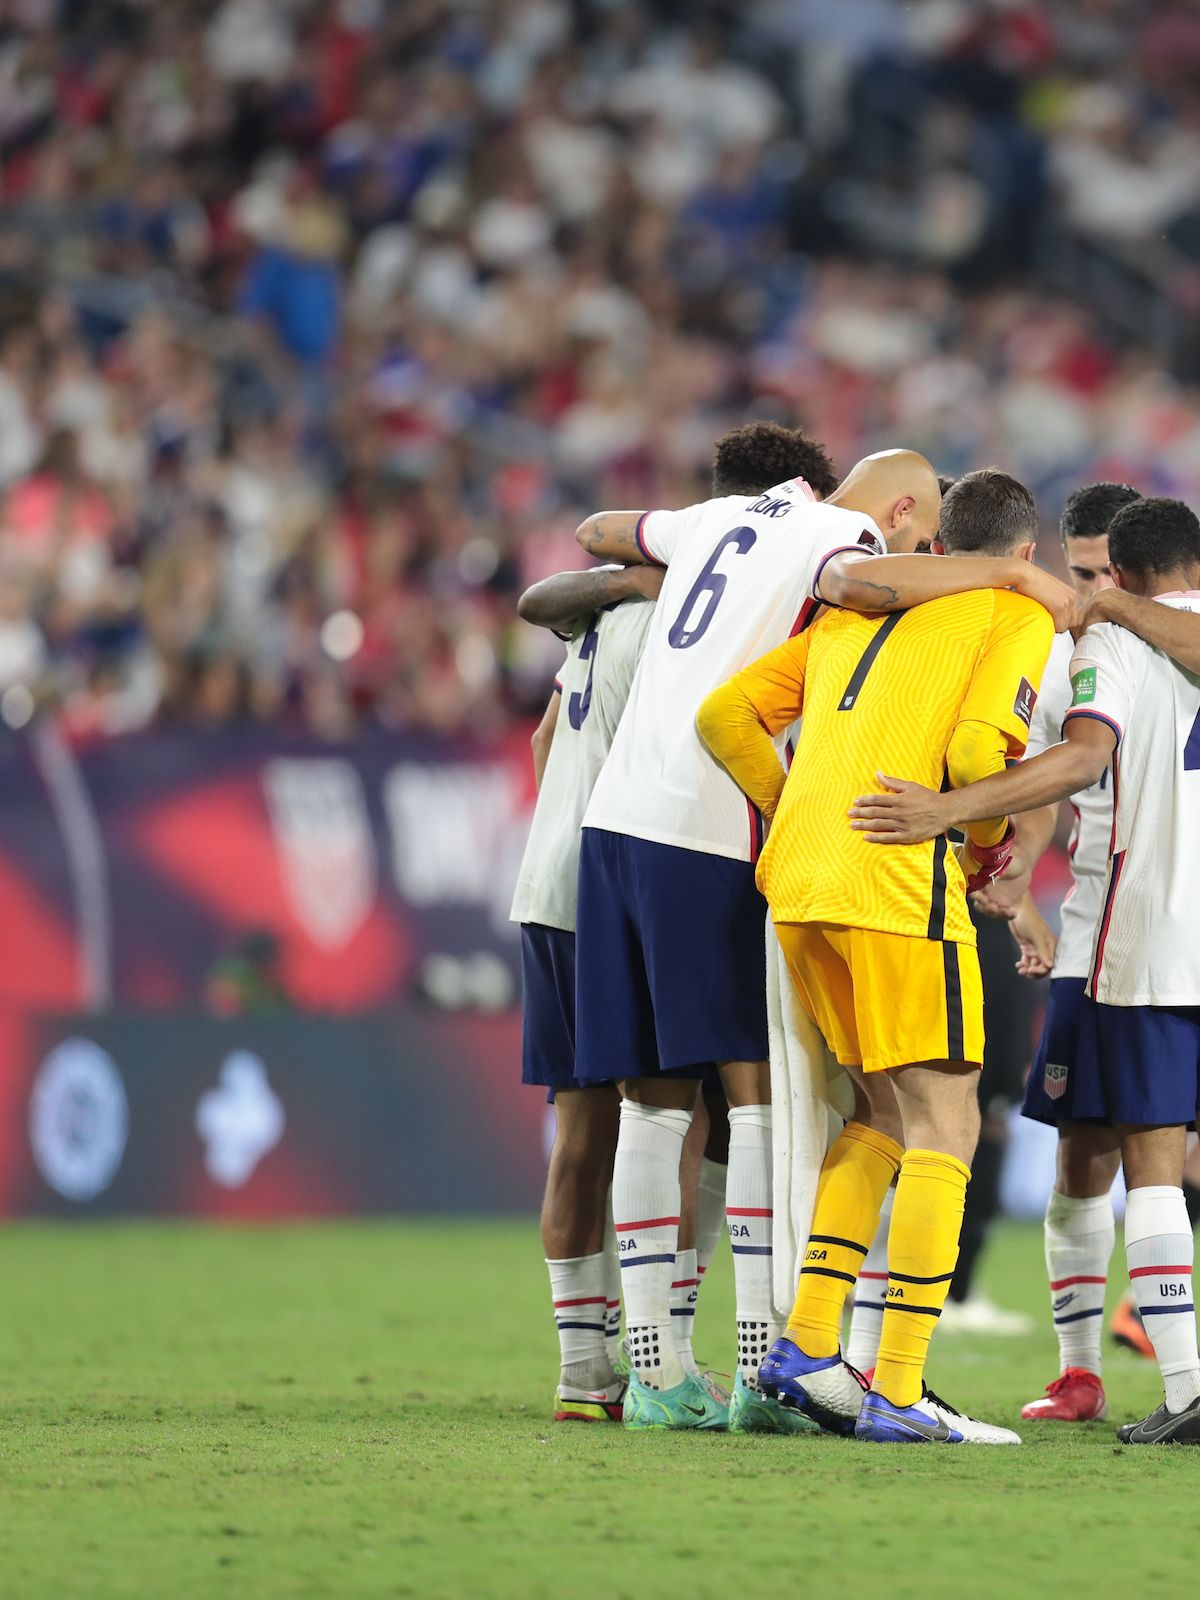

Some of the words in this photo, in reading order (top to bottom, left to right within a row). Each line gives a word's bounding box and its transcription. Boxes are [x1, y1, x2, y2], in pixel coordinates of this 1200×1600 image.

[668, 526, 757, 649] 6
[1046, 1066, 1067, 1080] USA
[1159, 1283, 1187, 1297] USA
